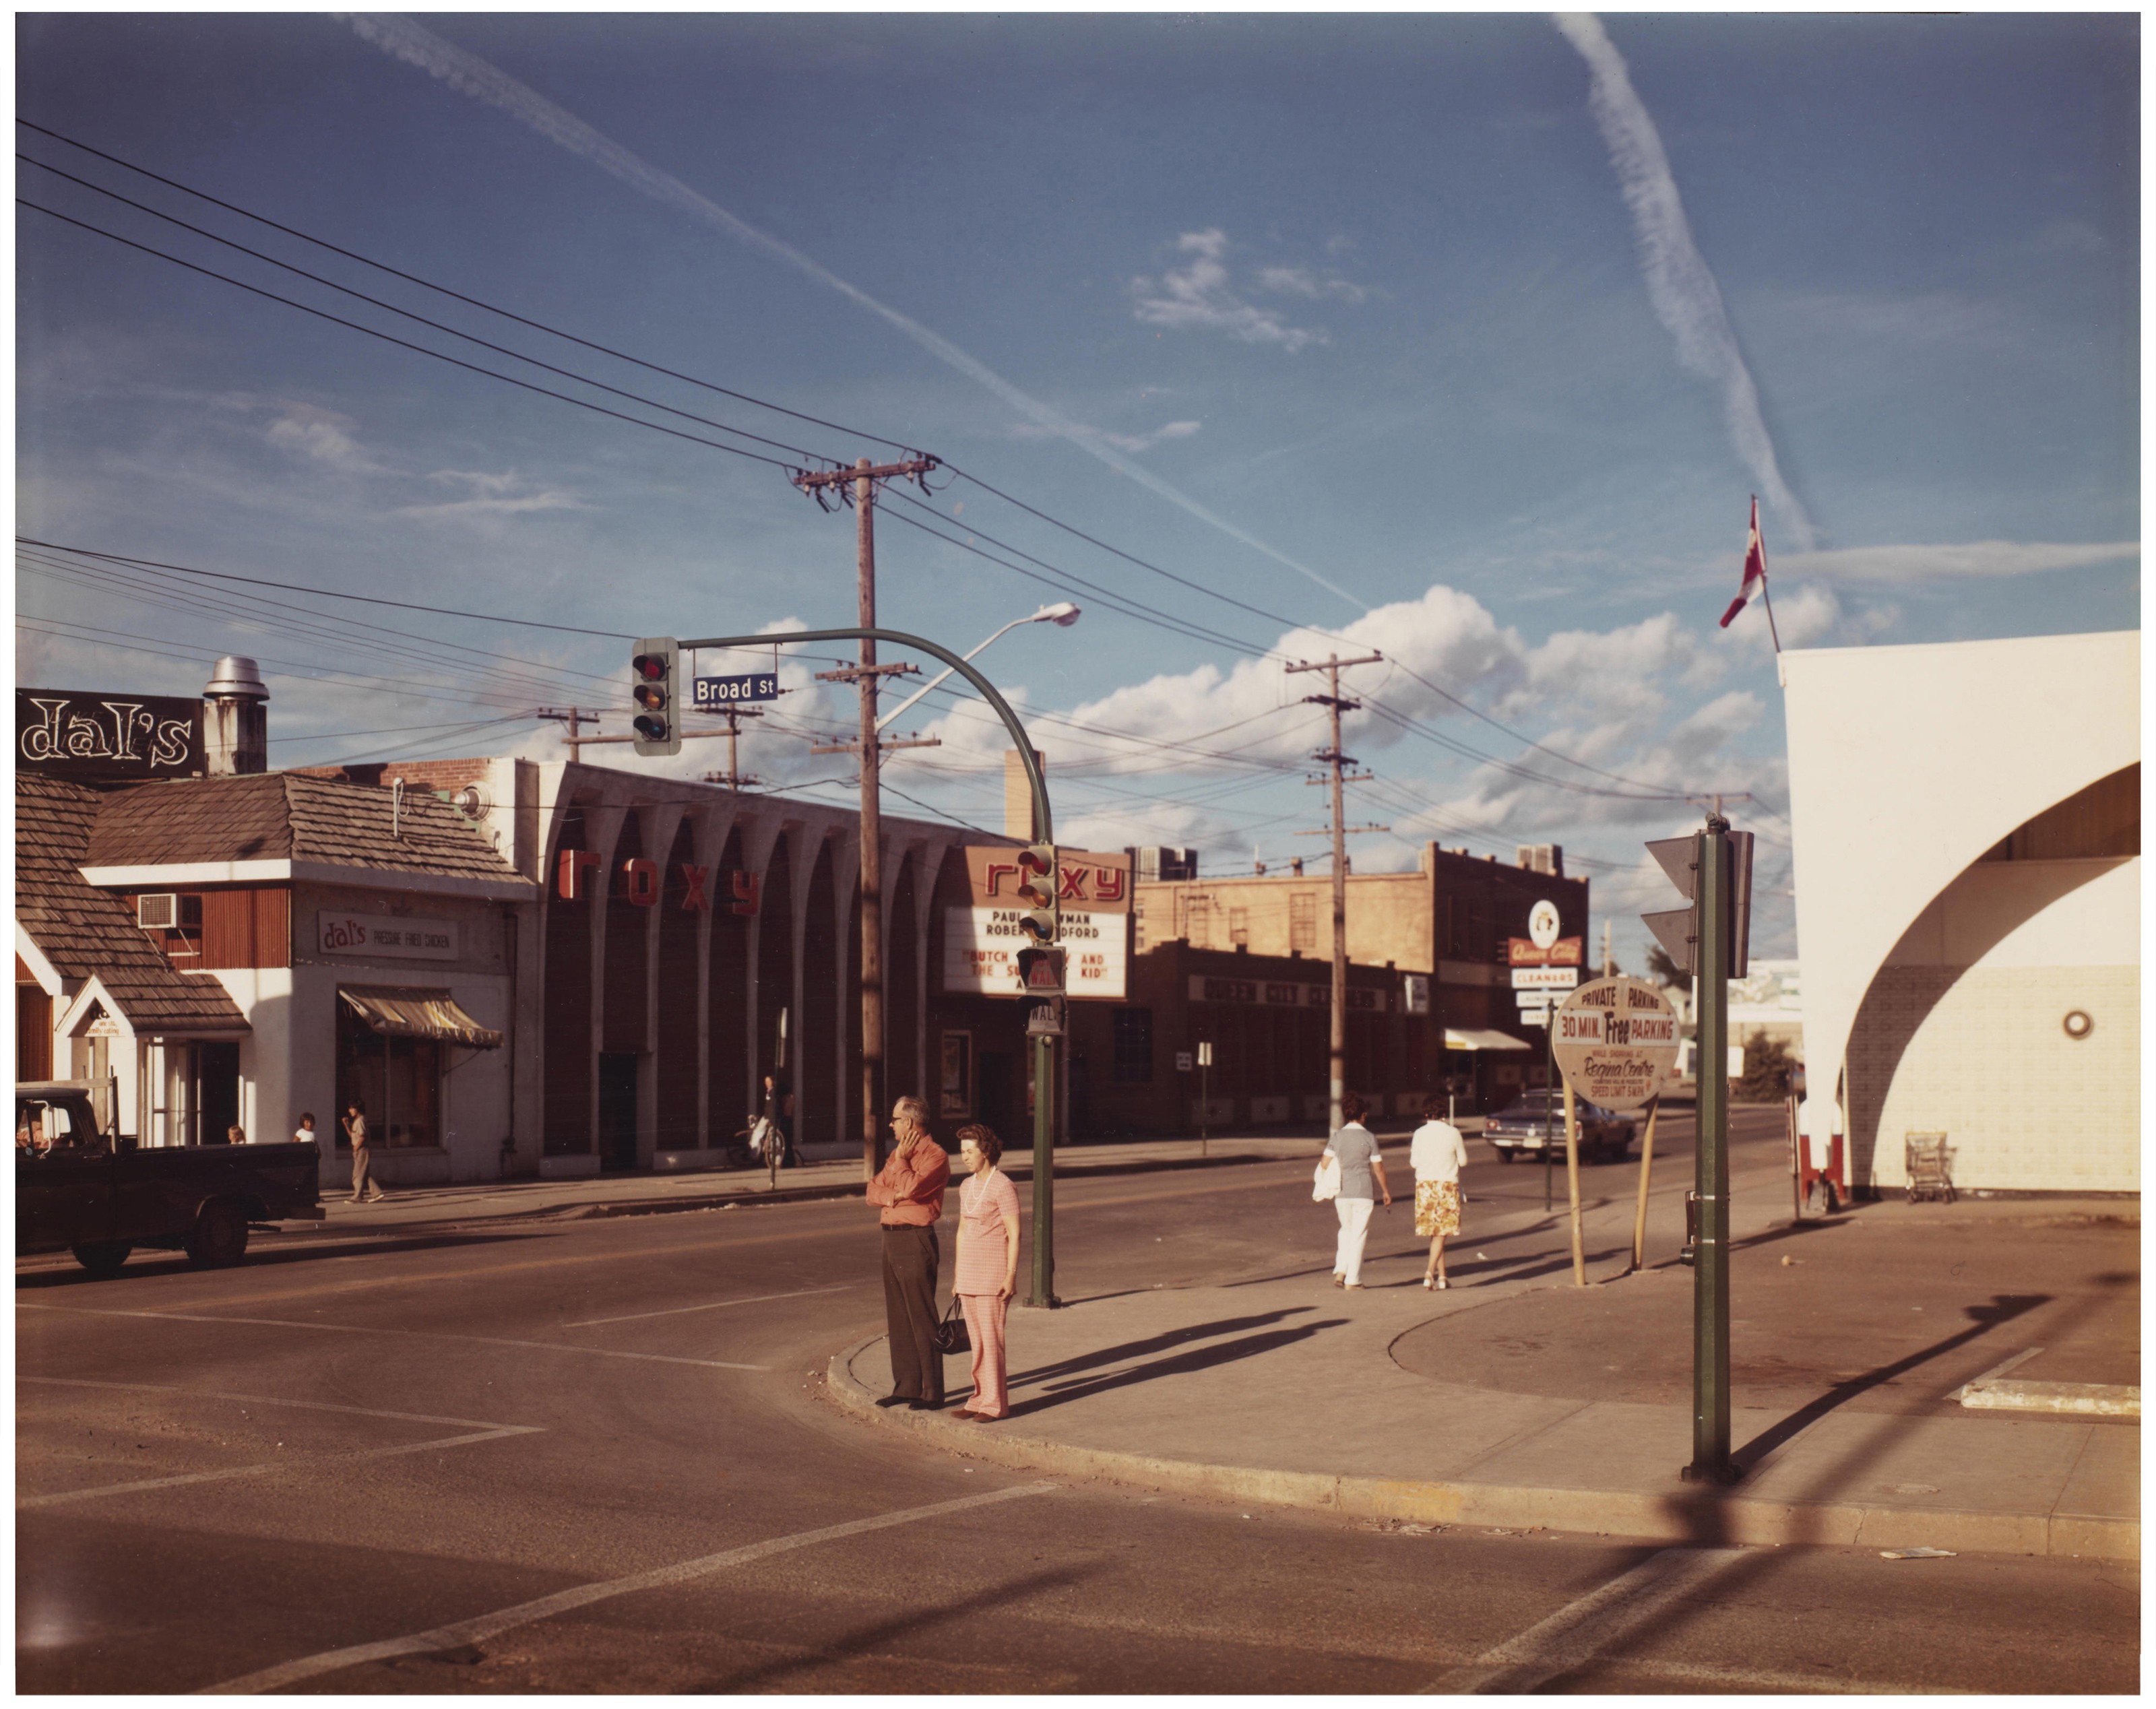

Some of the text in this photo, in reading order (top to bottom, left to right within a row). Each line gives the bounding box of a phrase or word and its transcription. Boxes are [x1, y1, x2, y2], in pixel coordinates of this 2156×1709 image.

[697, 677, 773, 701] Broad St
[22, 698, 192, 769] dal's
[559, 849, 760, 916] roxy
[992, 911, 1021, 922] PAUL
[324, 919, 366, 948] dal's
[406, 932, 422, 946] FRIED
[425, 934, 449, 948] CHICKEN
[986, 924, 1099, 938] ROBER DFORD
[1081, 954, 1104, 965] AND
[972, 965, 993, 976] THE
[1517, 973, 1573, 983] CLEANERS
[1582, 986, 1616, 1006] PRIVATE
[1628, 988, 1659, 1009] PARKING
[1032, 1006, 1056, 1021] WAL
[1562, 1011, 1673, 1044] 30 MIN. Free PARKING
[1610, 1050, 1634, 1058] SHOPPING
[1584, 1056, 1655, 1083] Regina Centre
[1591, 1085, 1609, 1097] SPEED
[1610, 1085, 1626, 1097] LIMIT
